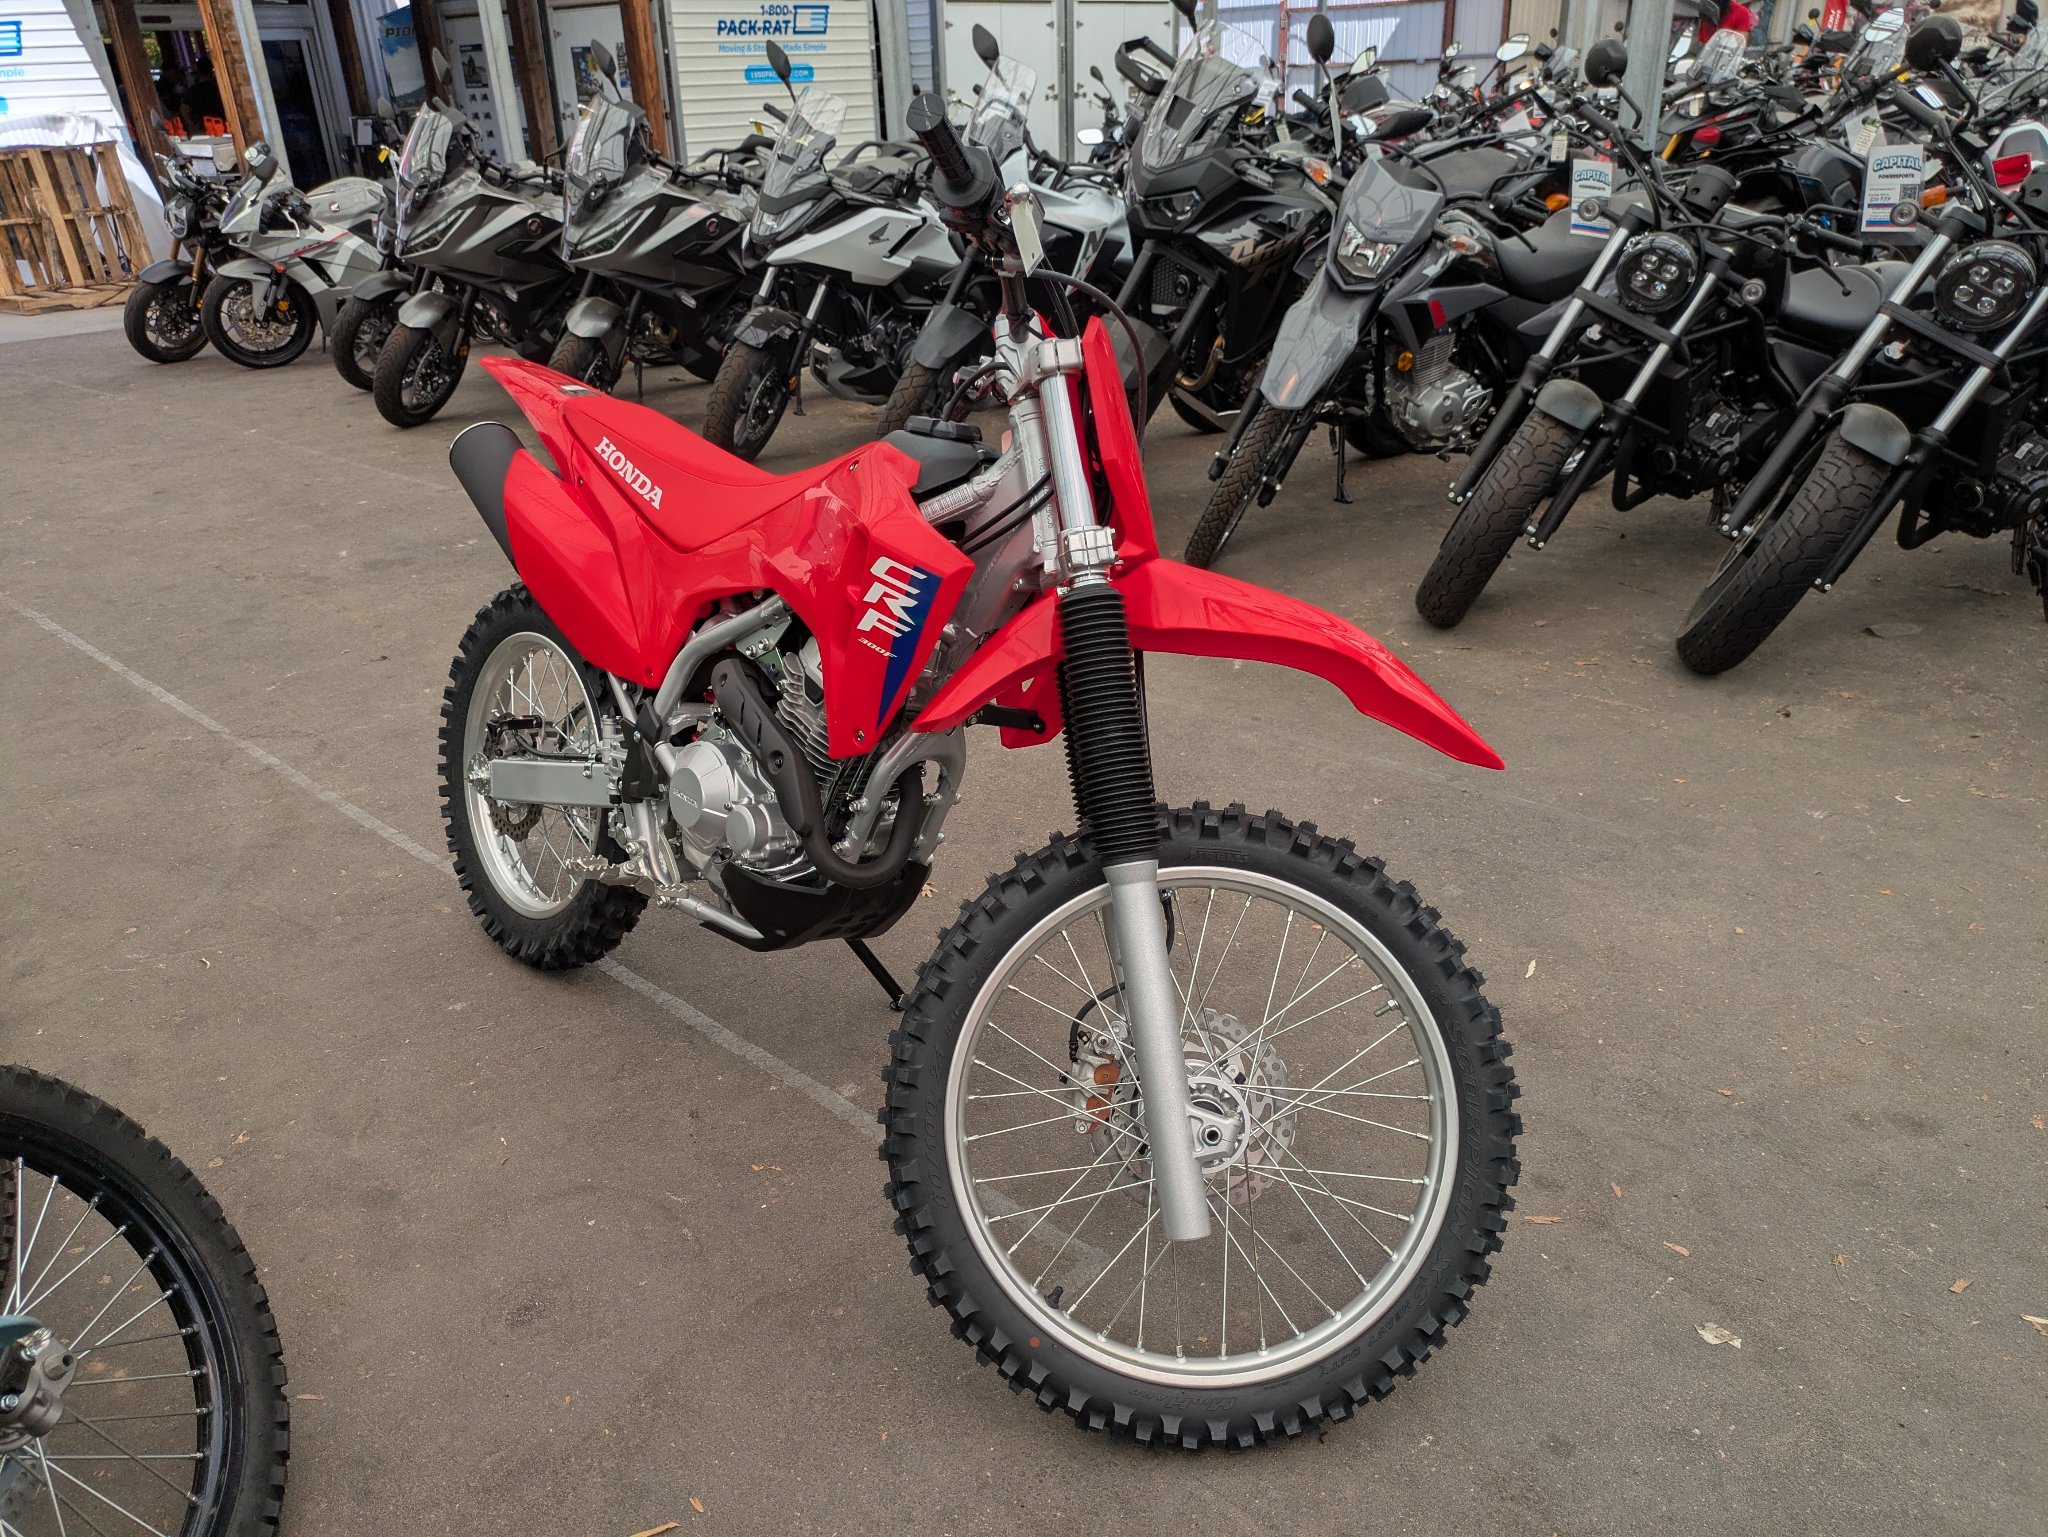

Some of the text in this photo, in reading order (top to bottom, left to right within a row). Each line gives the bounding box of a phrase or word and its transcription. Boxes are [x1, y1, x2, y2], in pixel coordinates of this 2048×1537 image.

[717, 20, 791, 36] PACK-RAT
[718, 43, 746, 54] Moving
[746, 43, 753, 53] &
[783, 42, 801, 52] Made
[803, 42, 827, 53] Simple
[1873, 155, 1921, 172] CAPITAL
[1574, 169, 1611, 187] CAPITAL
[594, 436, 663, 510] HONDA
[856, 556, 927, 638] CRF
[1445, 1020, 1482, 1240] SCORPION
[1319, 1346, 1361, 1378] DUTY
